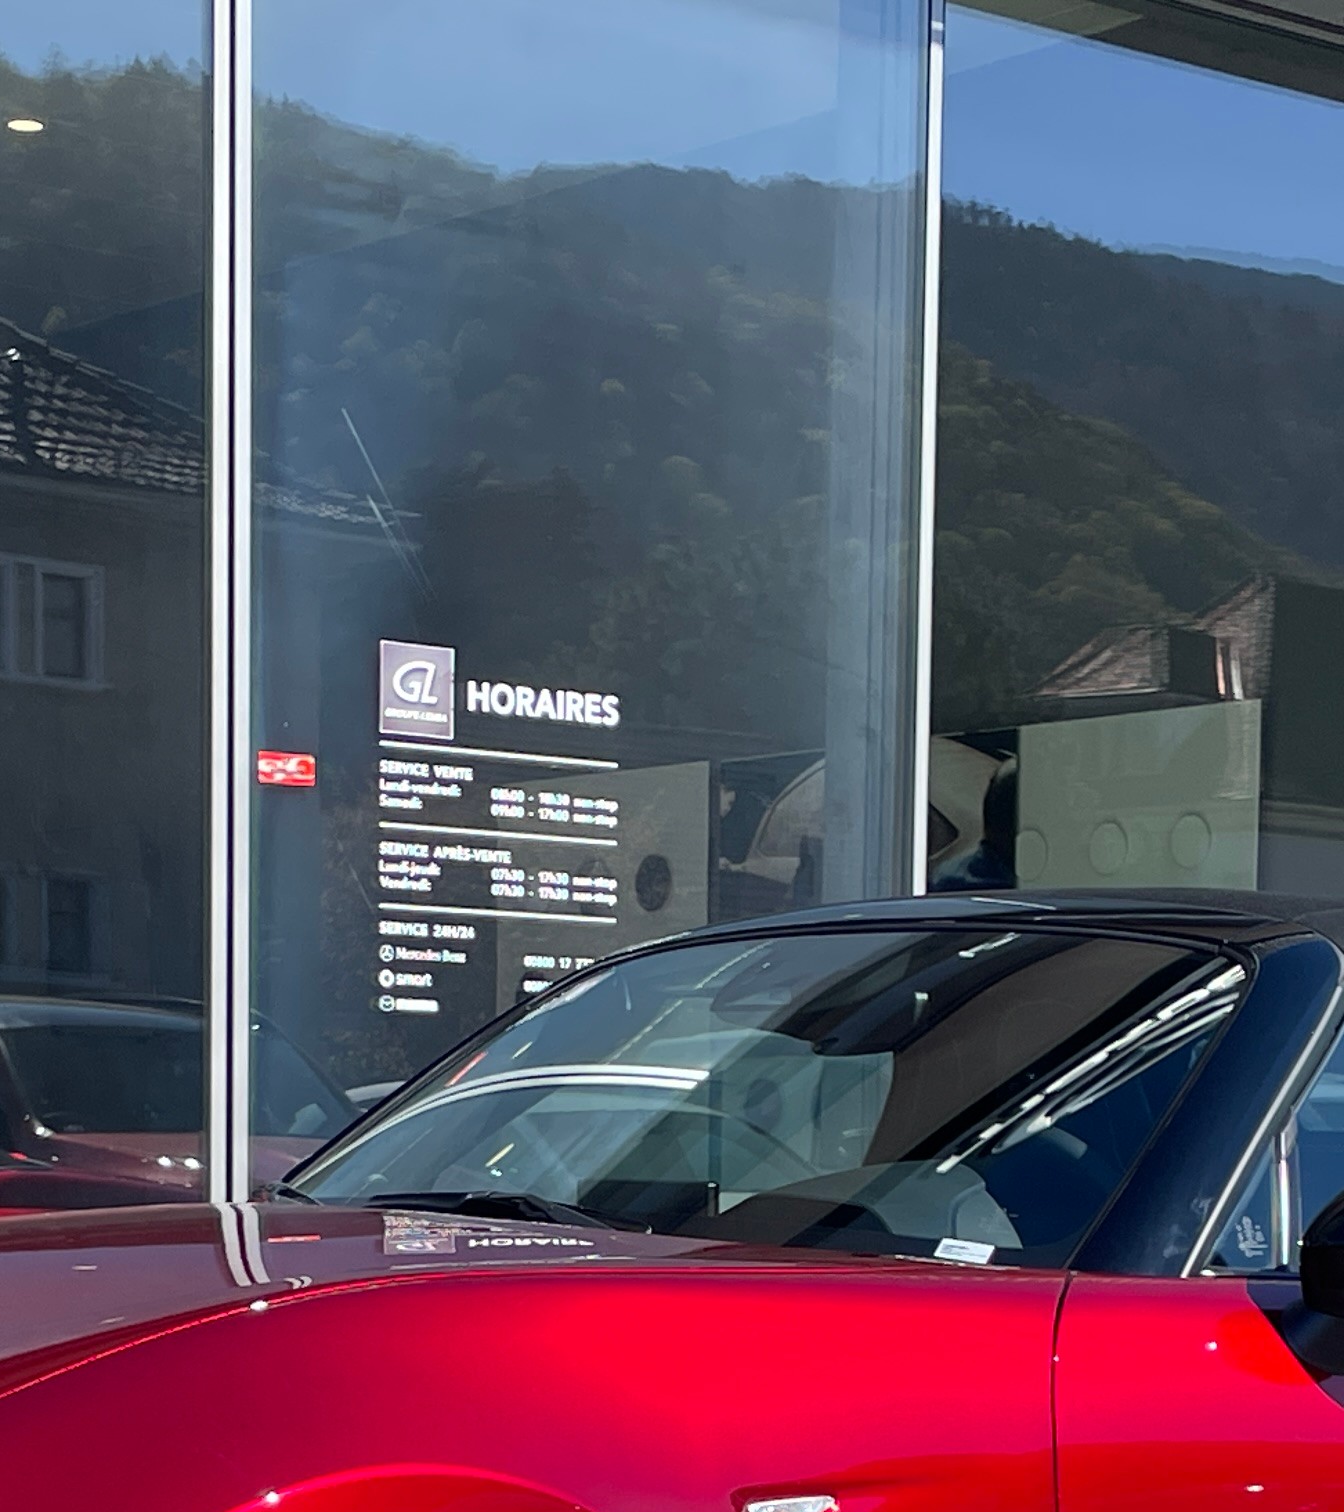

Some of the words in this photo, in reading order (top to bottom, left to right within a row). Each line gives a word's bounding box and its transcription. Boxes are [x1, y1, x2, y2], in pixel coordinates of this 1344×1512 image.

[466, 679, 621, 727] HORAIRES
[379, 759, 430, 778] SERVICE
[433, 764, 474, 781] VENTE
[378, 841, 429, 858] SERVICE
[433, 845, 512, 864] APRÈS-VENTE
[378, 920, 429, 937] SERVICE
[432, 923, 476, 939] 24H/24
[395, 973, 433, 987] smart
